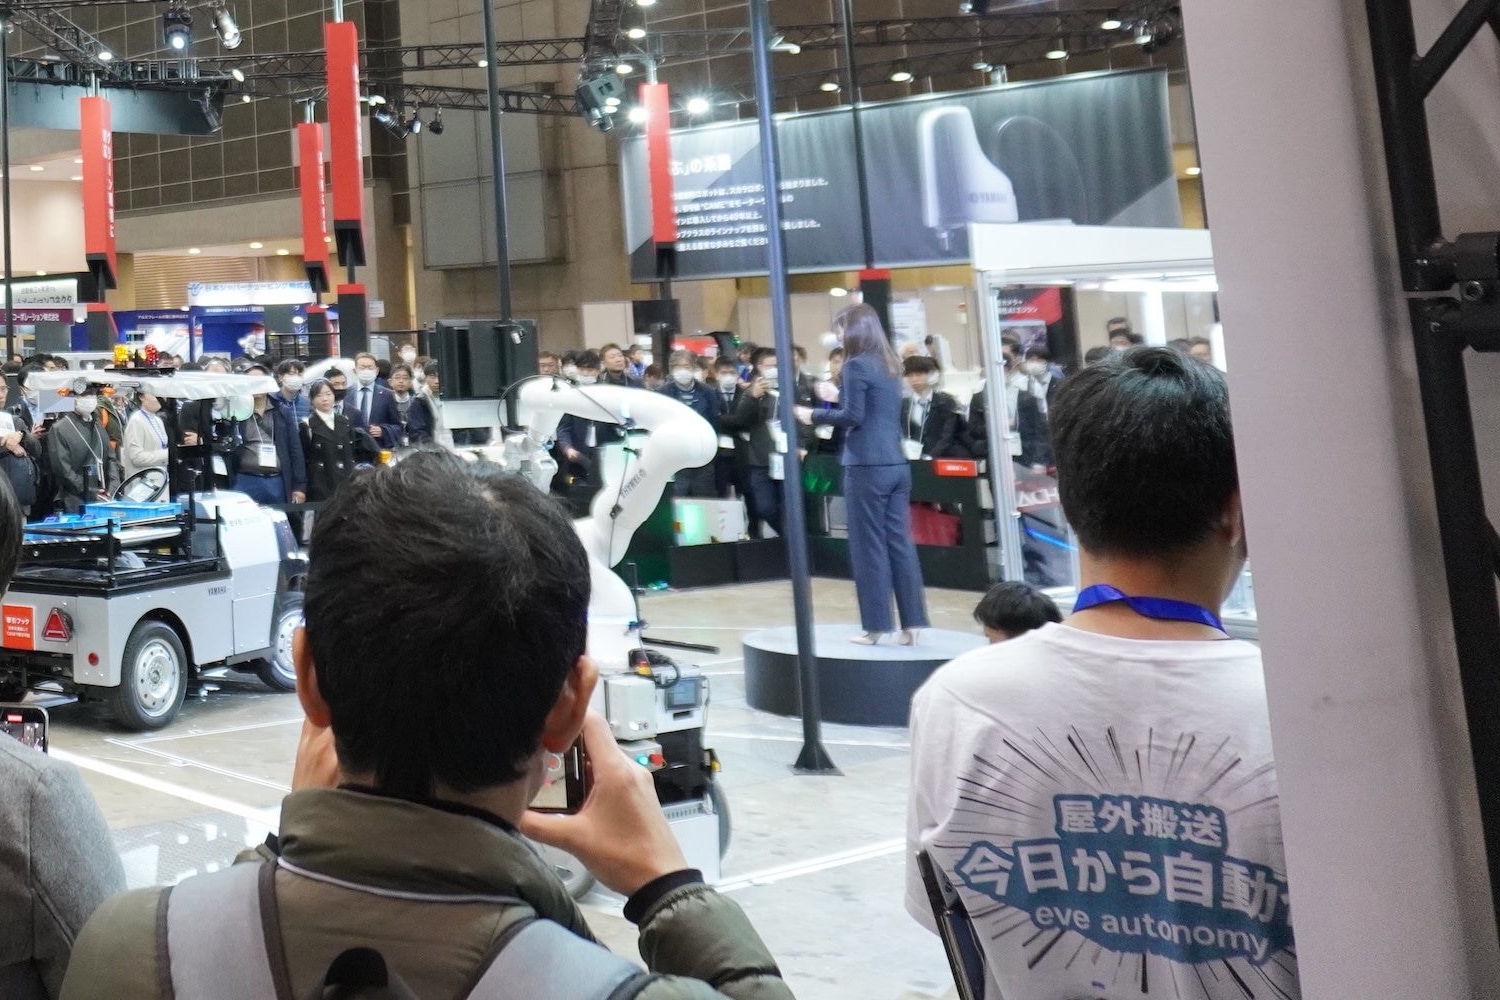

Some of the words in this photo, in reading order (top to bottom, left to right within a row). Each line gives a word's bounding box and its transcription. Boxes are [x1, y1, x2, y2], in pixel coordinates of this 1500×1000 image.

[1060, 800, 1223, 847] 屋外搬送
[960, 844, 1292, 926] 今日から自動
[1036, 905, 1091, 930] eve
[1101, 913, 1269, 960] autonomy
